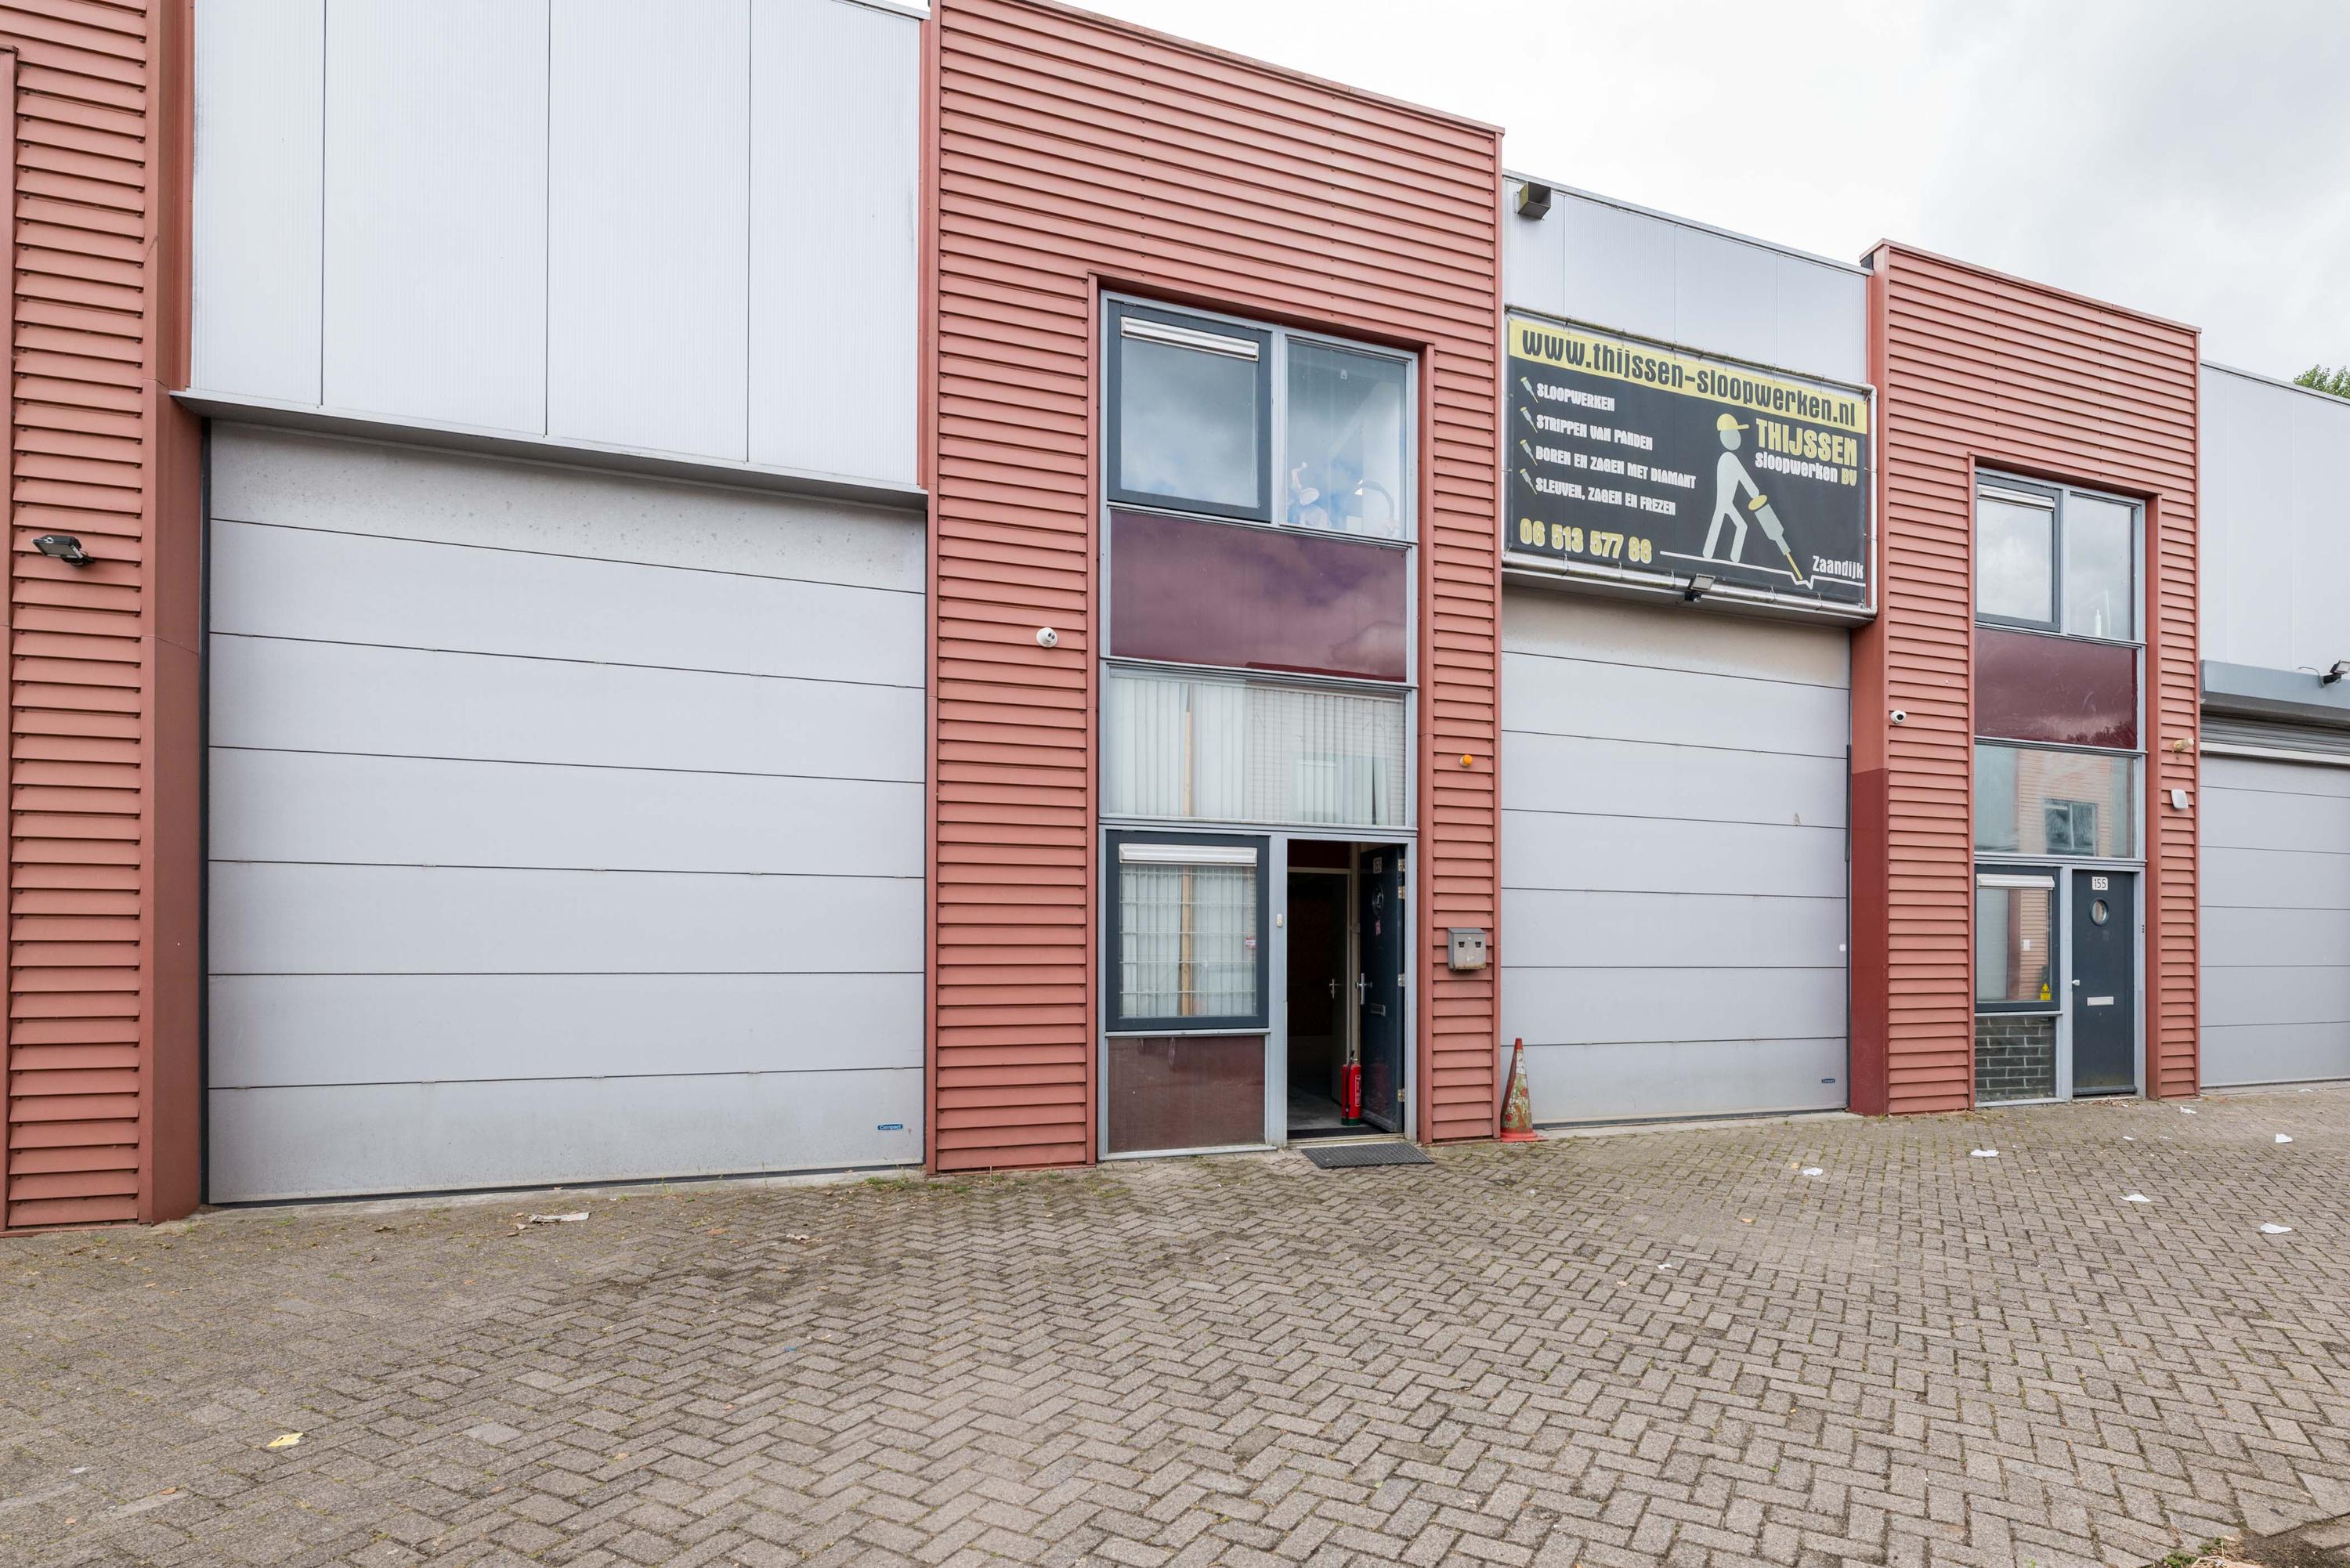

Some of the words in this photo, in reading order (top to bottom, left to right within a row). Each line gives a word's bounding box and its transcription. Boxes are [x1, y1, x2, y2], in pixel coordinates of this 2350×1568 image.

[1522, 329, 1856, 427] www.thijssen-sloopwerken.nl
[1536, 383, 1615, 412] SLOOPWERKEN
[1536, 414, 1587, 439] STRIPPEN
[1589, 425, 1611, 443] VAN
[1614, 429, 1654, 451] PANDEN
[1755, 417, 1857, 468] THIJSSEN
[1535, 445, 1571, 466] BOREN
[1574, 453, 1588, 469] EN
[1590, 456, 1625, 475] ZAGEN
[1627, 462, 1649, 480] MET
[1650, 467, 1697, 490] DIAMANT
[1755, 451, 1838, 483] sloopwerken
[1841, 467, 1857, 486] BV
[1535, 477, 1585, 501] SLEUVEN,
[1588, 486, 1622, 506] ZAGEN
[1625, 493, 1638, 509] EN
[1640, 496, 1676, 516] FREZEN
[1520, 517, 1546, 547] 06
[1551, 523, 1584, 554] 513
[1589, 529, 1625, 559] 577
[1628, 536, 1653, 565] 88
[1812, 555, 1864, 580] Zaandijk
[2094, 878, 2106, 889] 155
